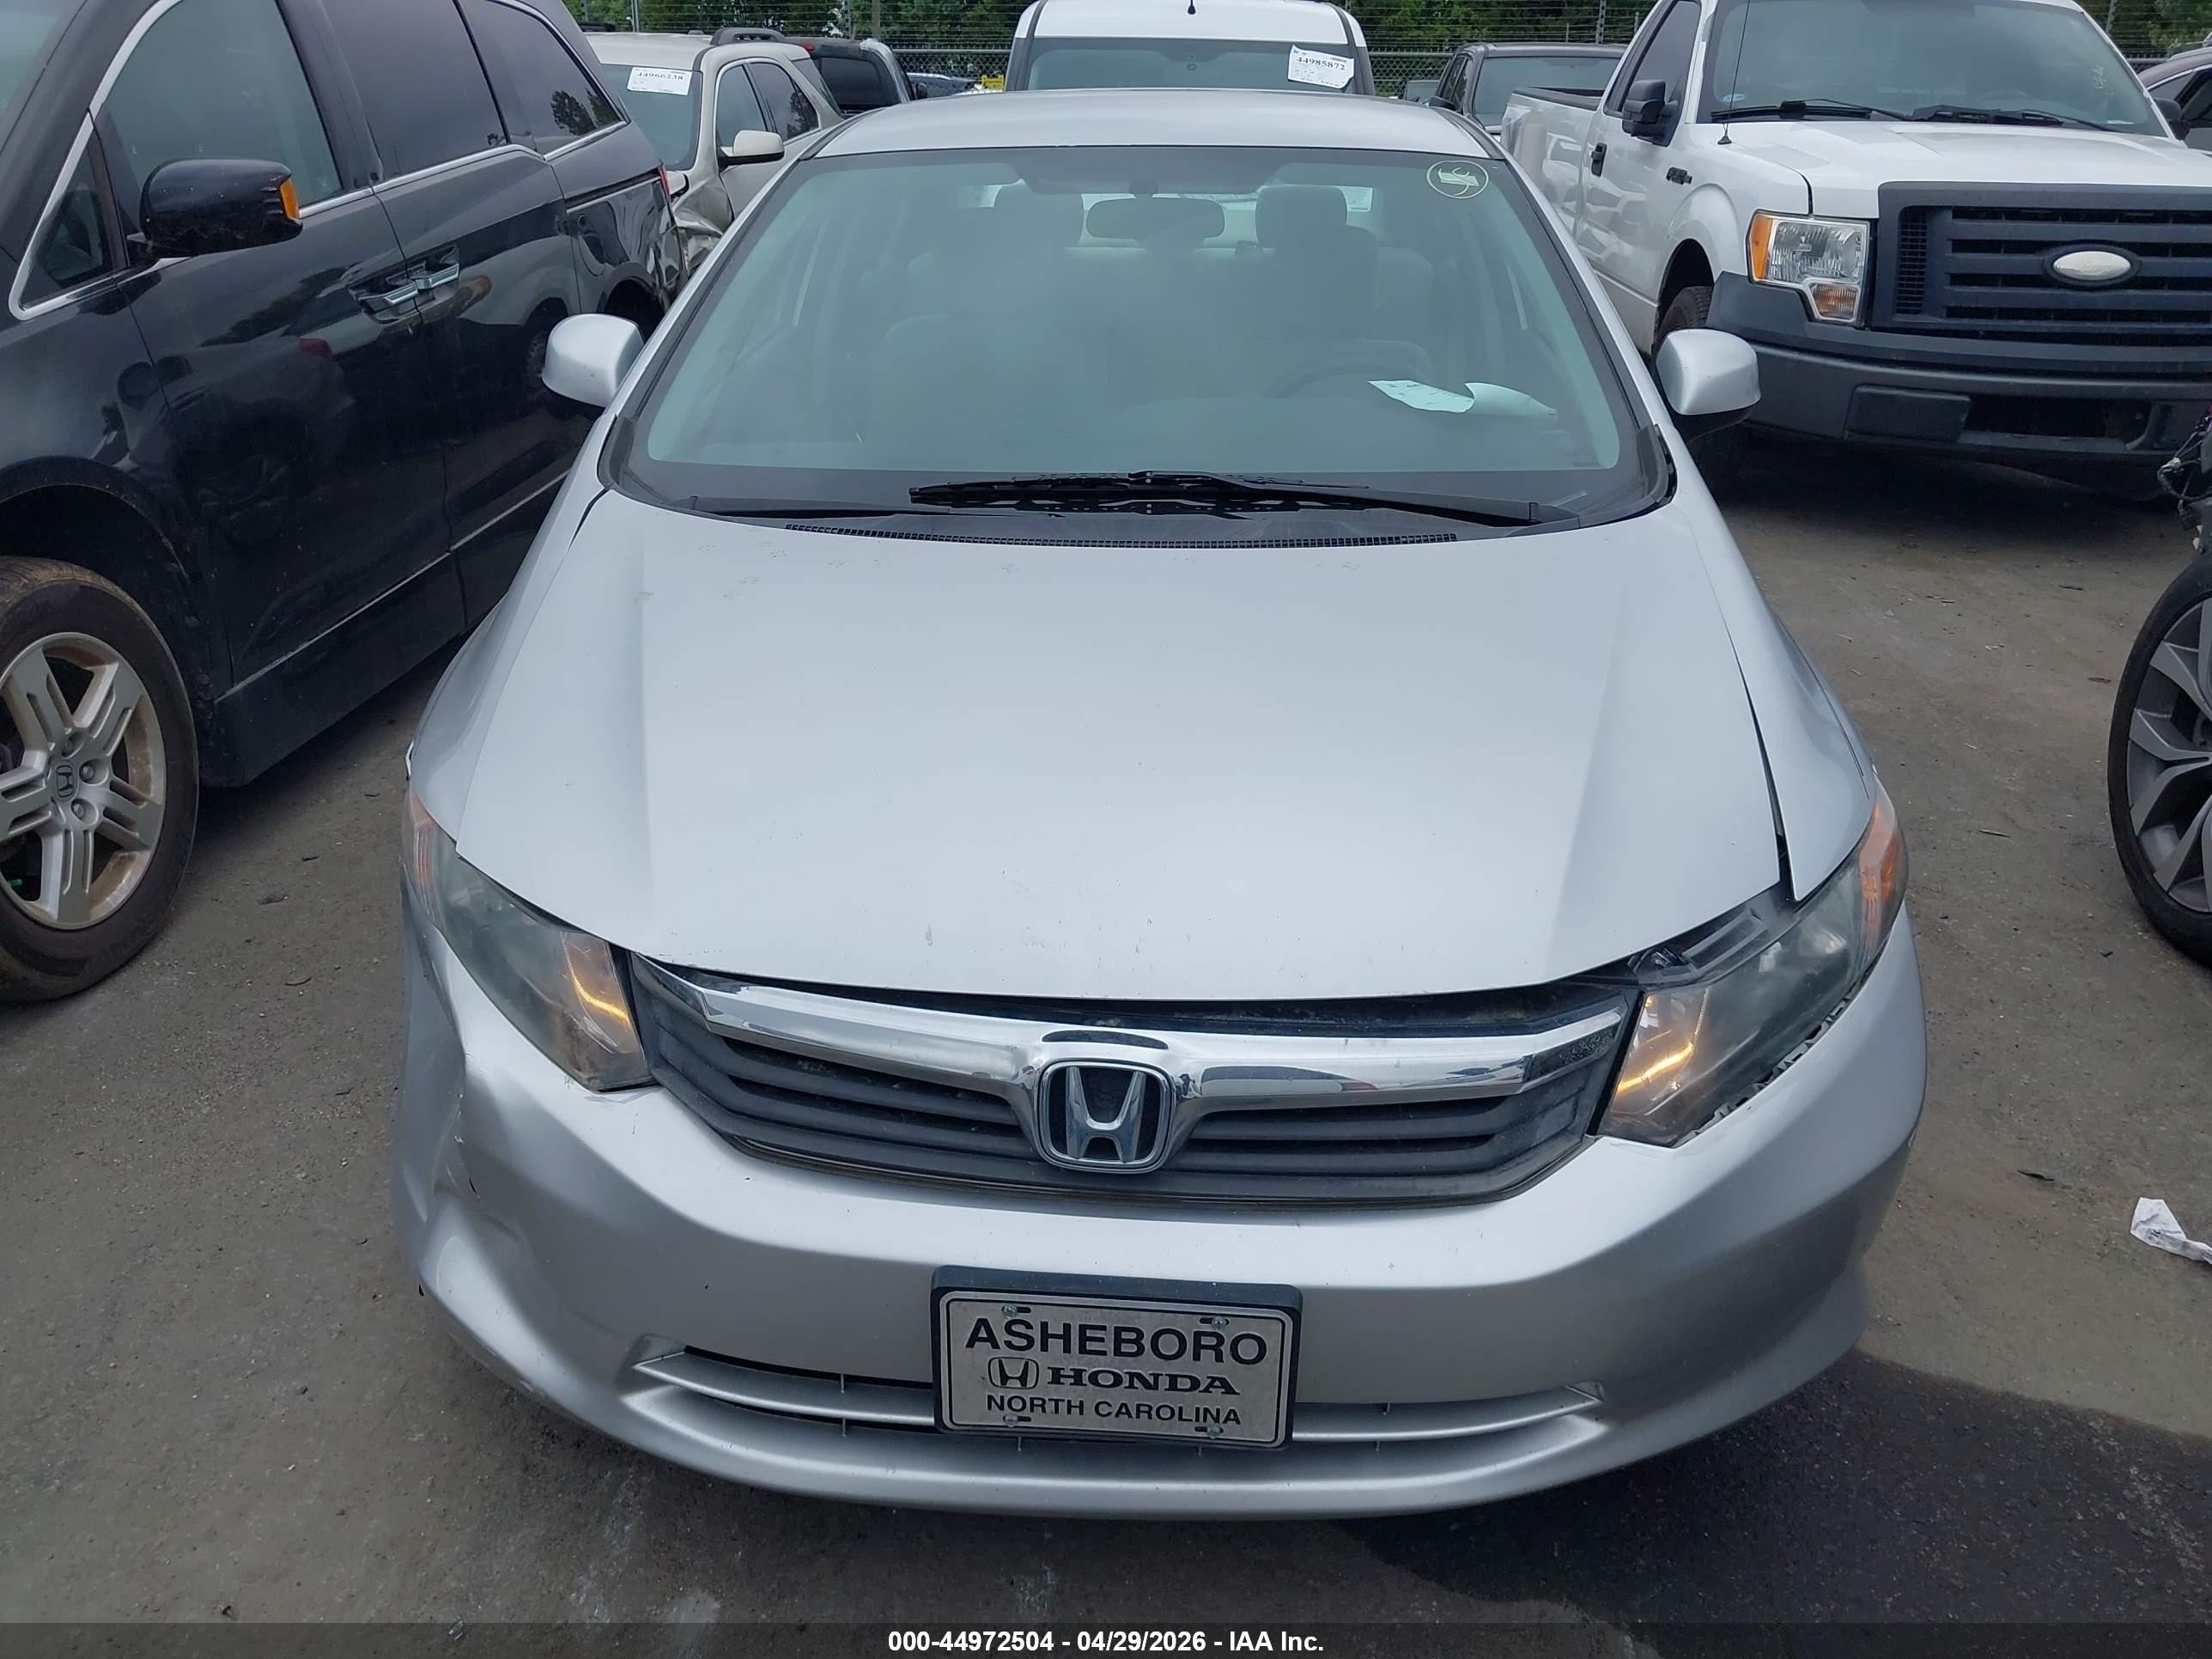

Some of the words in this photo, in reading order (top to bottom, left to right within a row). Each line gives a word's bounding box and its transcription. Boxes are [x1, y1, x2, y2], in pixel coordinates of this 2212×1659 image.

[1296, 56, 1346, 70] 44985872
[965, 1316, 1267, 1365] ASHEBORO
[1047, 1366, 1240, 1395] HONDA
[987, 1395, 1084, 1417] NORTH
[1094, 1401, 1242, 1425] CAROLINA
